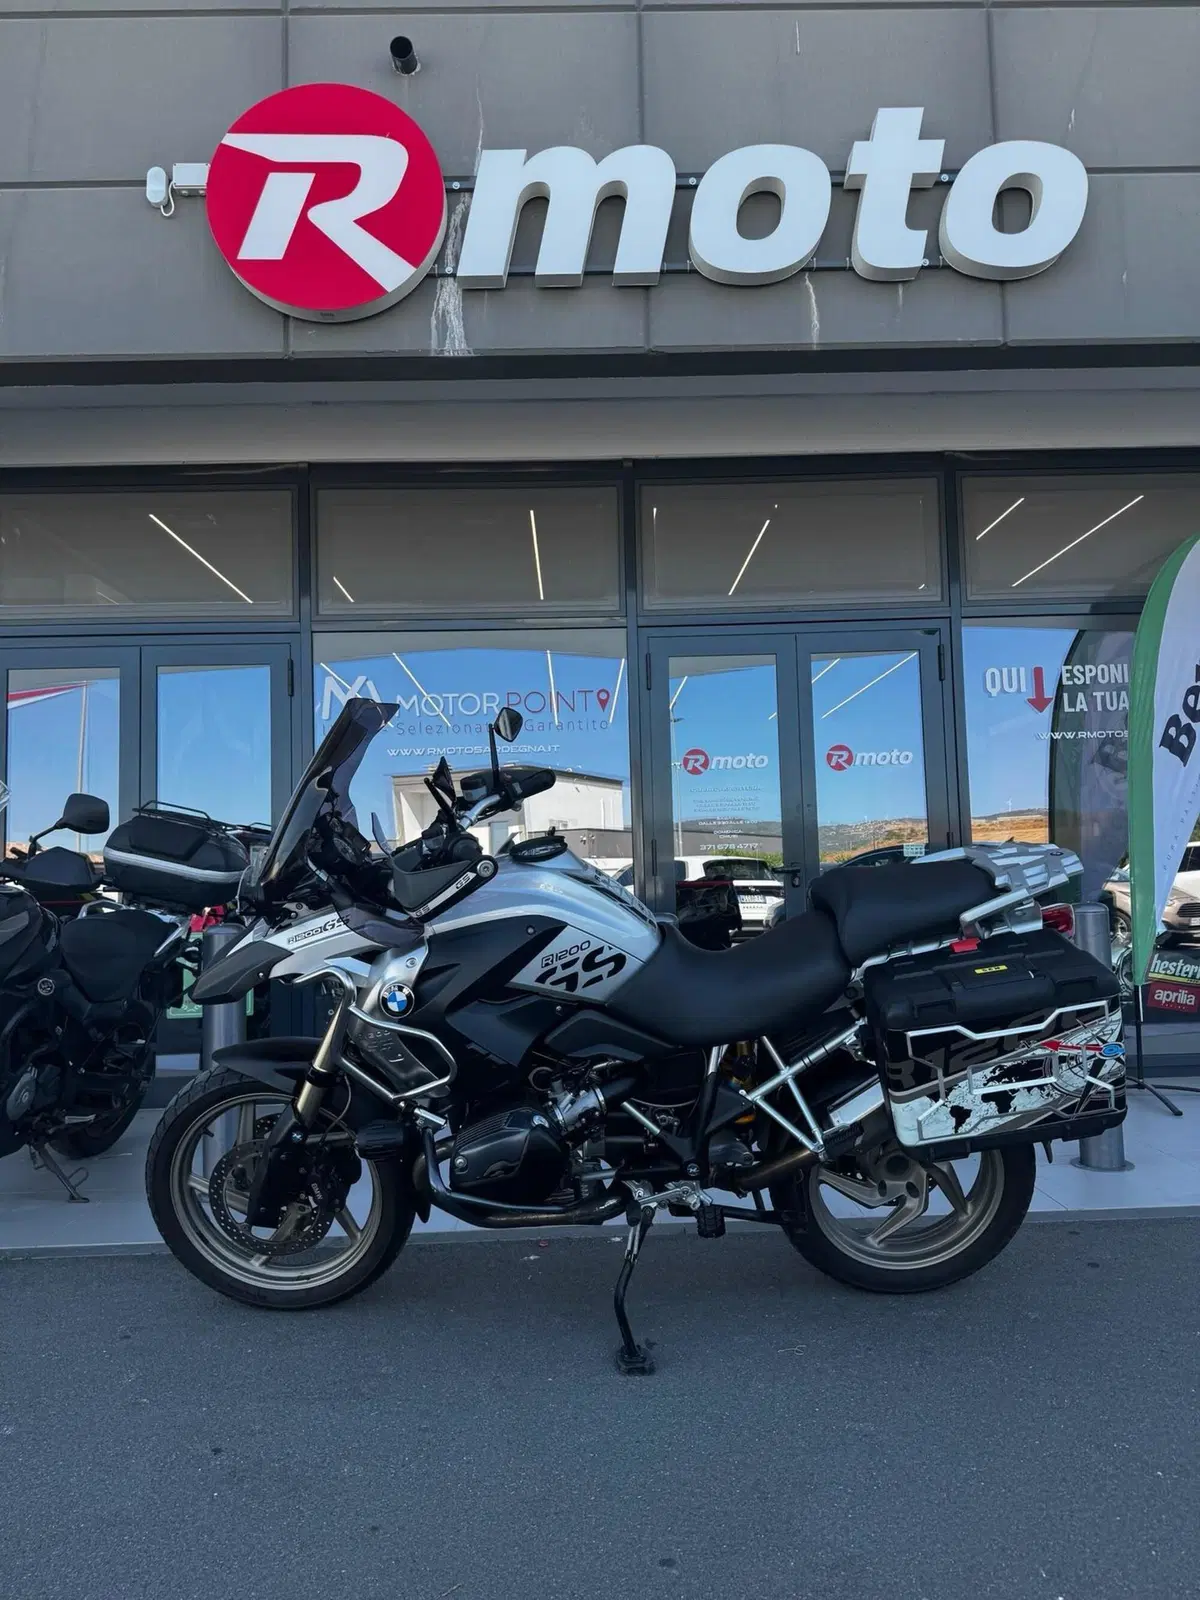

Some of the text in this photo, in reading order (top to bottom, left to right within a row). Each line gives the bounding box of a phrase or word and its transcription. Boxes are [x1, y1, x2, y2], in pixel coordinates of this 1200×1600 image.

[985, 667, 1027, 697] QUI
[1061, 664, 1128, 686] ESPONI
[395, 692, 500, 717] MOTOR
[1063, 691, 1128, 713] LA TUA
[396, 718, 609, 736] Selezionat Garantito
[1159, 664, 1200, 767] Be
[541, 939, 591, 969] R1200
[534, 945, 627, 993] GS
[1154, 988, 1196, 1006] aprilia
